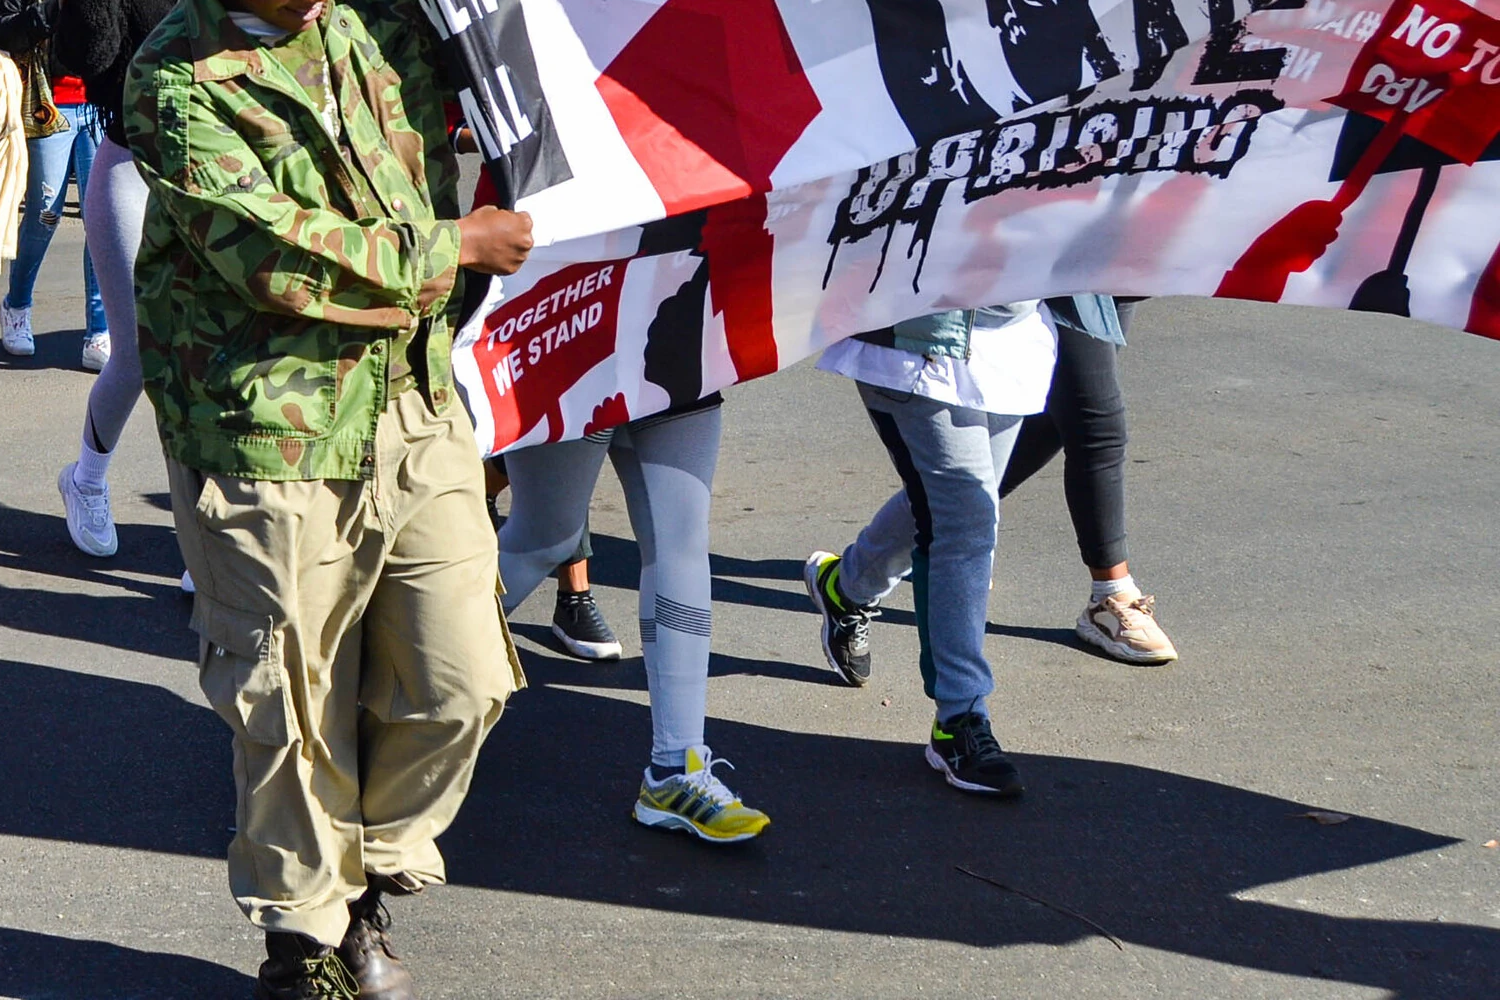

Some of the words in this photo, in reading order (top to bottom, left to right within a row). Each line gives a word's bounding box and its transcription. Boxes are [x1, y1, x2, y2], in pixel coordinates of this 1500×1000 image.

[1391, 3, 1462, 59] NO
[849, 104, 1263, 227] UPRISING
[487, 265, 614, 352] TOGETHER
[492, 348, 524, 397] WE
[528, 301, 603, 366] STAND
